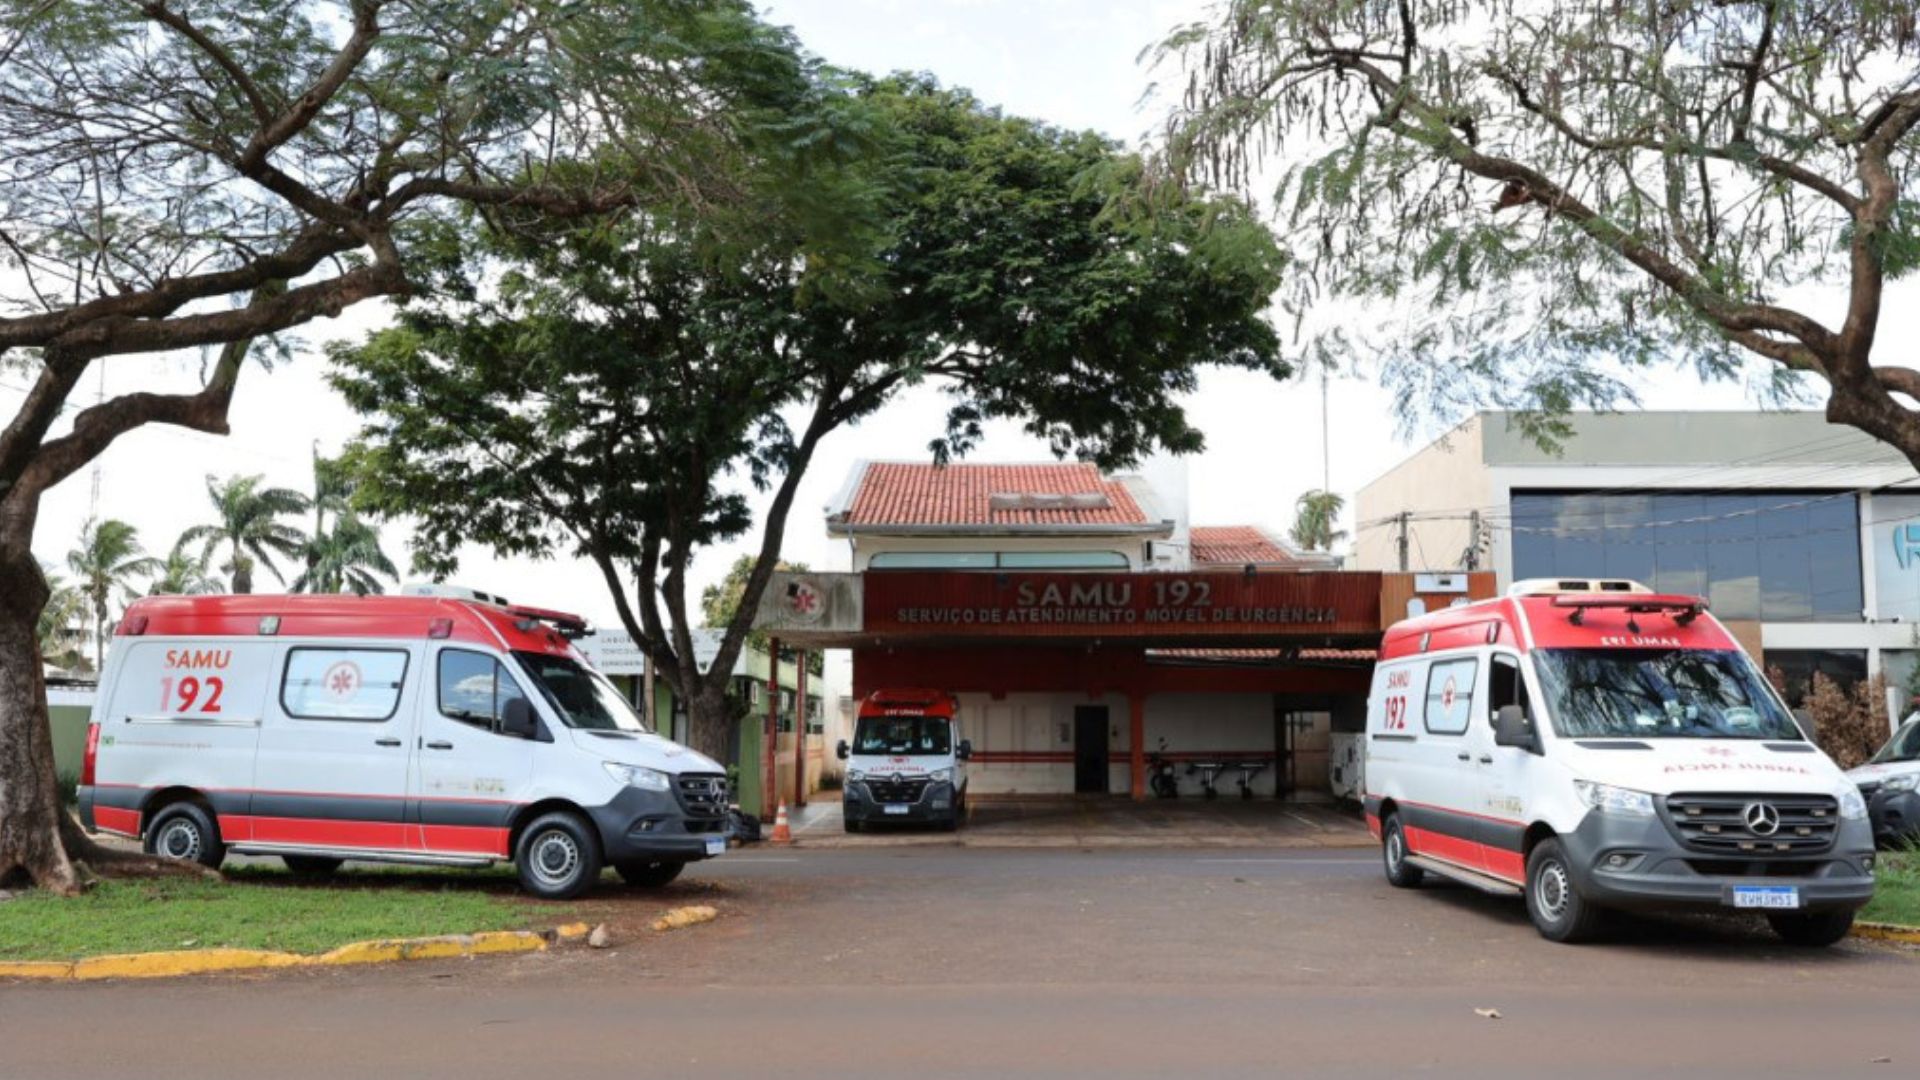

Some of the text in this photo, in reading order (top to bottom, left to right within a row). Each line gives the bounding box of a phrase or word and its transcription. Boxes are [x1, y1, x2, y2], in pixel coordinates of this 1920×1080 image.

[1017, 579, 1212, 606] SAMU 192
[899, 608, 974, 624] SERVIÇO
[979, 608, 1000, 623] DE
[1006, 608, 1136, 623] ATENDIMENTO
[1213, 608, 1234, 622] DE
[165, 649, 232, 669] SAMU
[1387, 670, 1409, 689] SAMU
[161, 676, 223, 712] 192
[1384, 696, 1405, 729] 192
